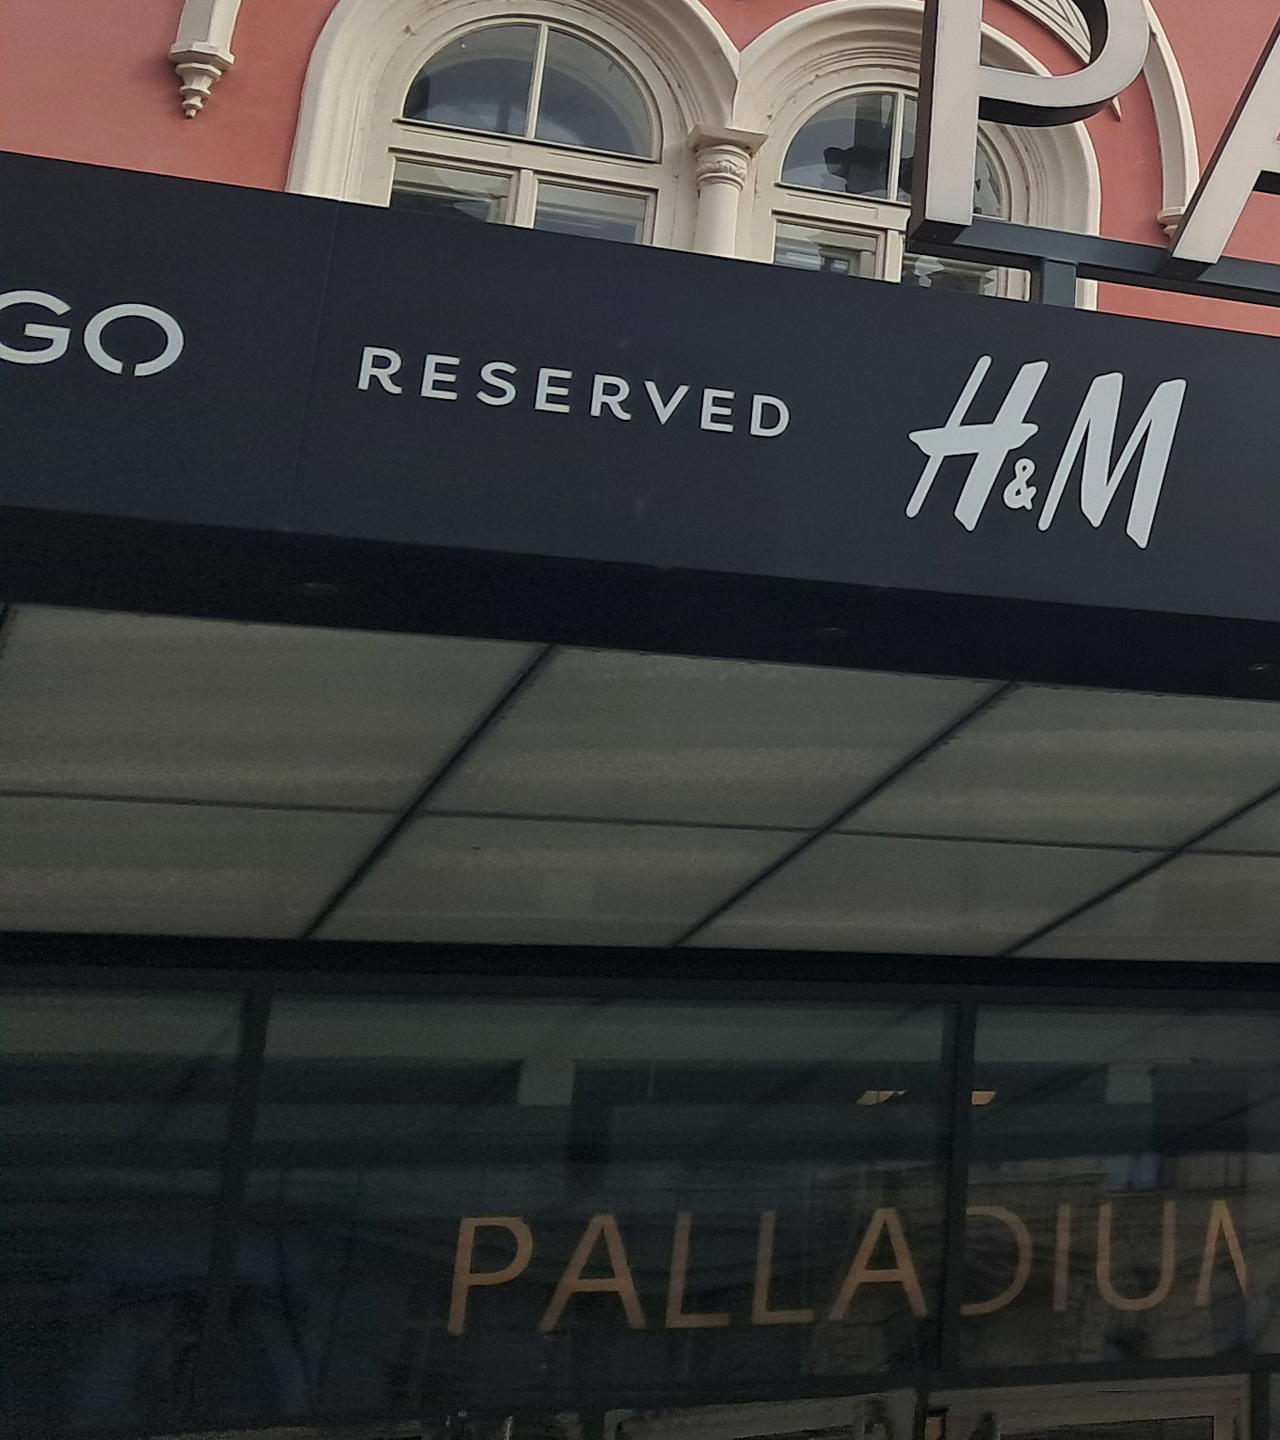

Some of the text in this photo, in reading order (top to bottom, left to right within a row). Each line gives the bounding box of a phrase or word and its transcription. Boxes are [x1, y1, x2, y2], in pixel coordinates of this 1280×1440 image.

[0, 290, 184, 376] GO
[357, 346, 791, 438] RESERVED
[906, 355, 1187, 549] H&M
